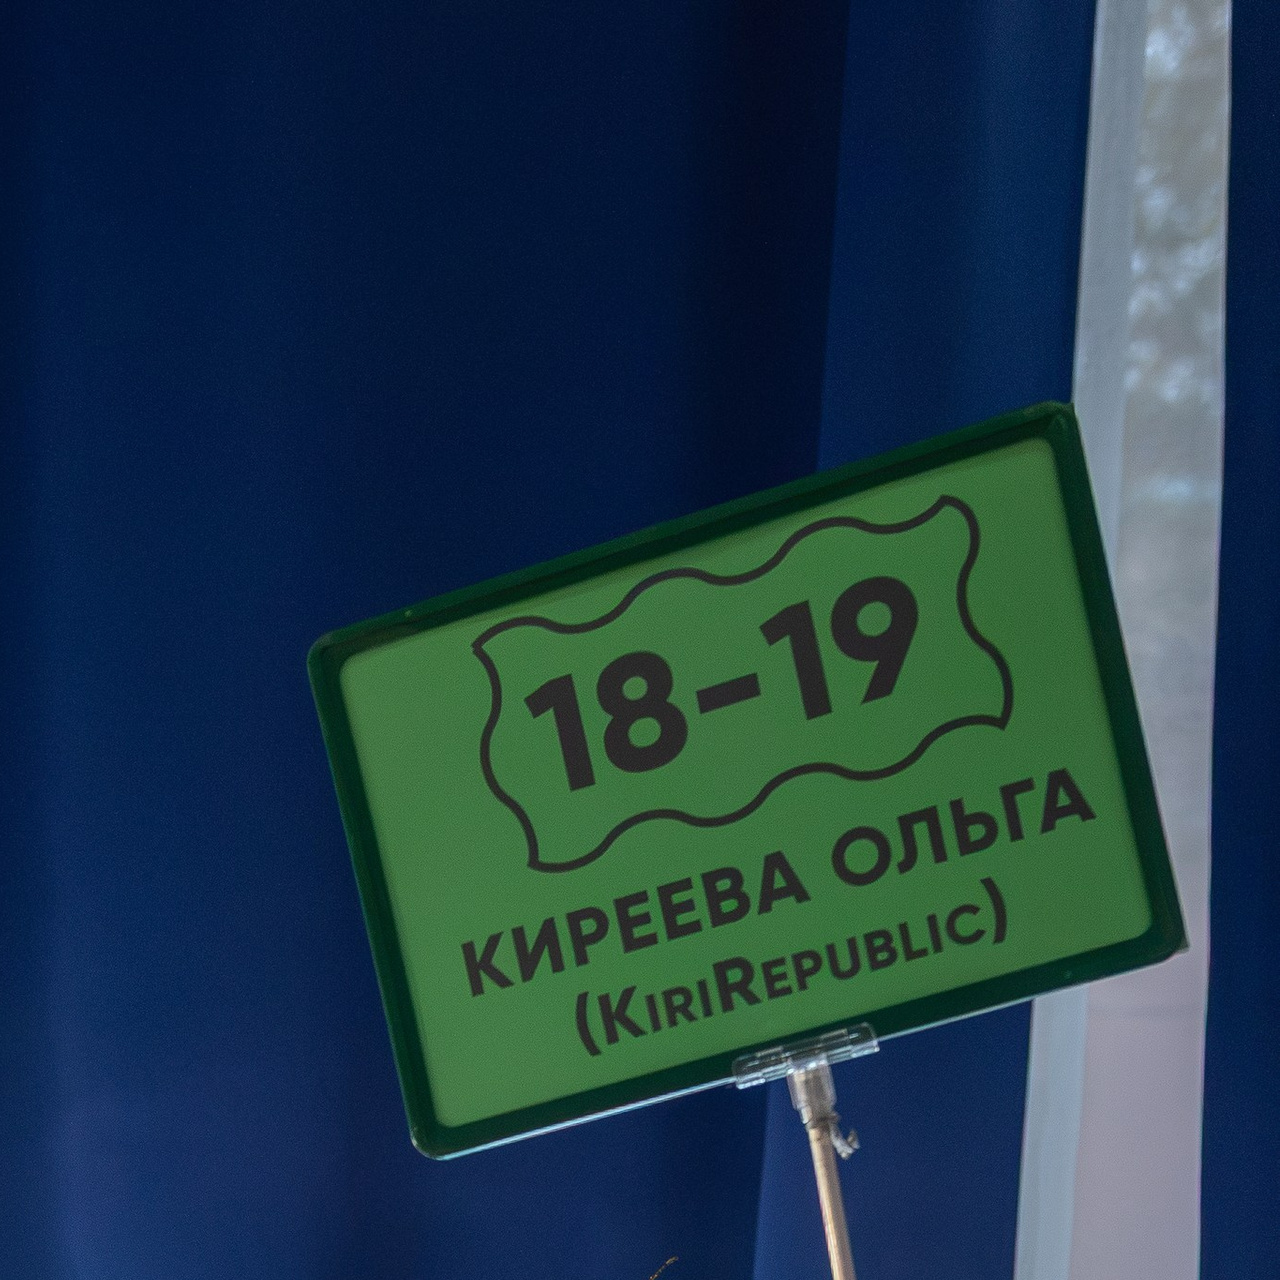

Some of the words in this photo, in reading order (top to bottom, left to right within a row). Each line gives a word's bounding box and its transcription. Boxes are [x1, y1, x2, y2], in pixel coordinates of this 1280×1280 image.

[524, 577, 919, 791] 18-19
[461, 849, 811, 998] КИРЕЕВА
[832, 767, 1097, 887] ОЛЬГА
